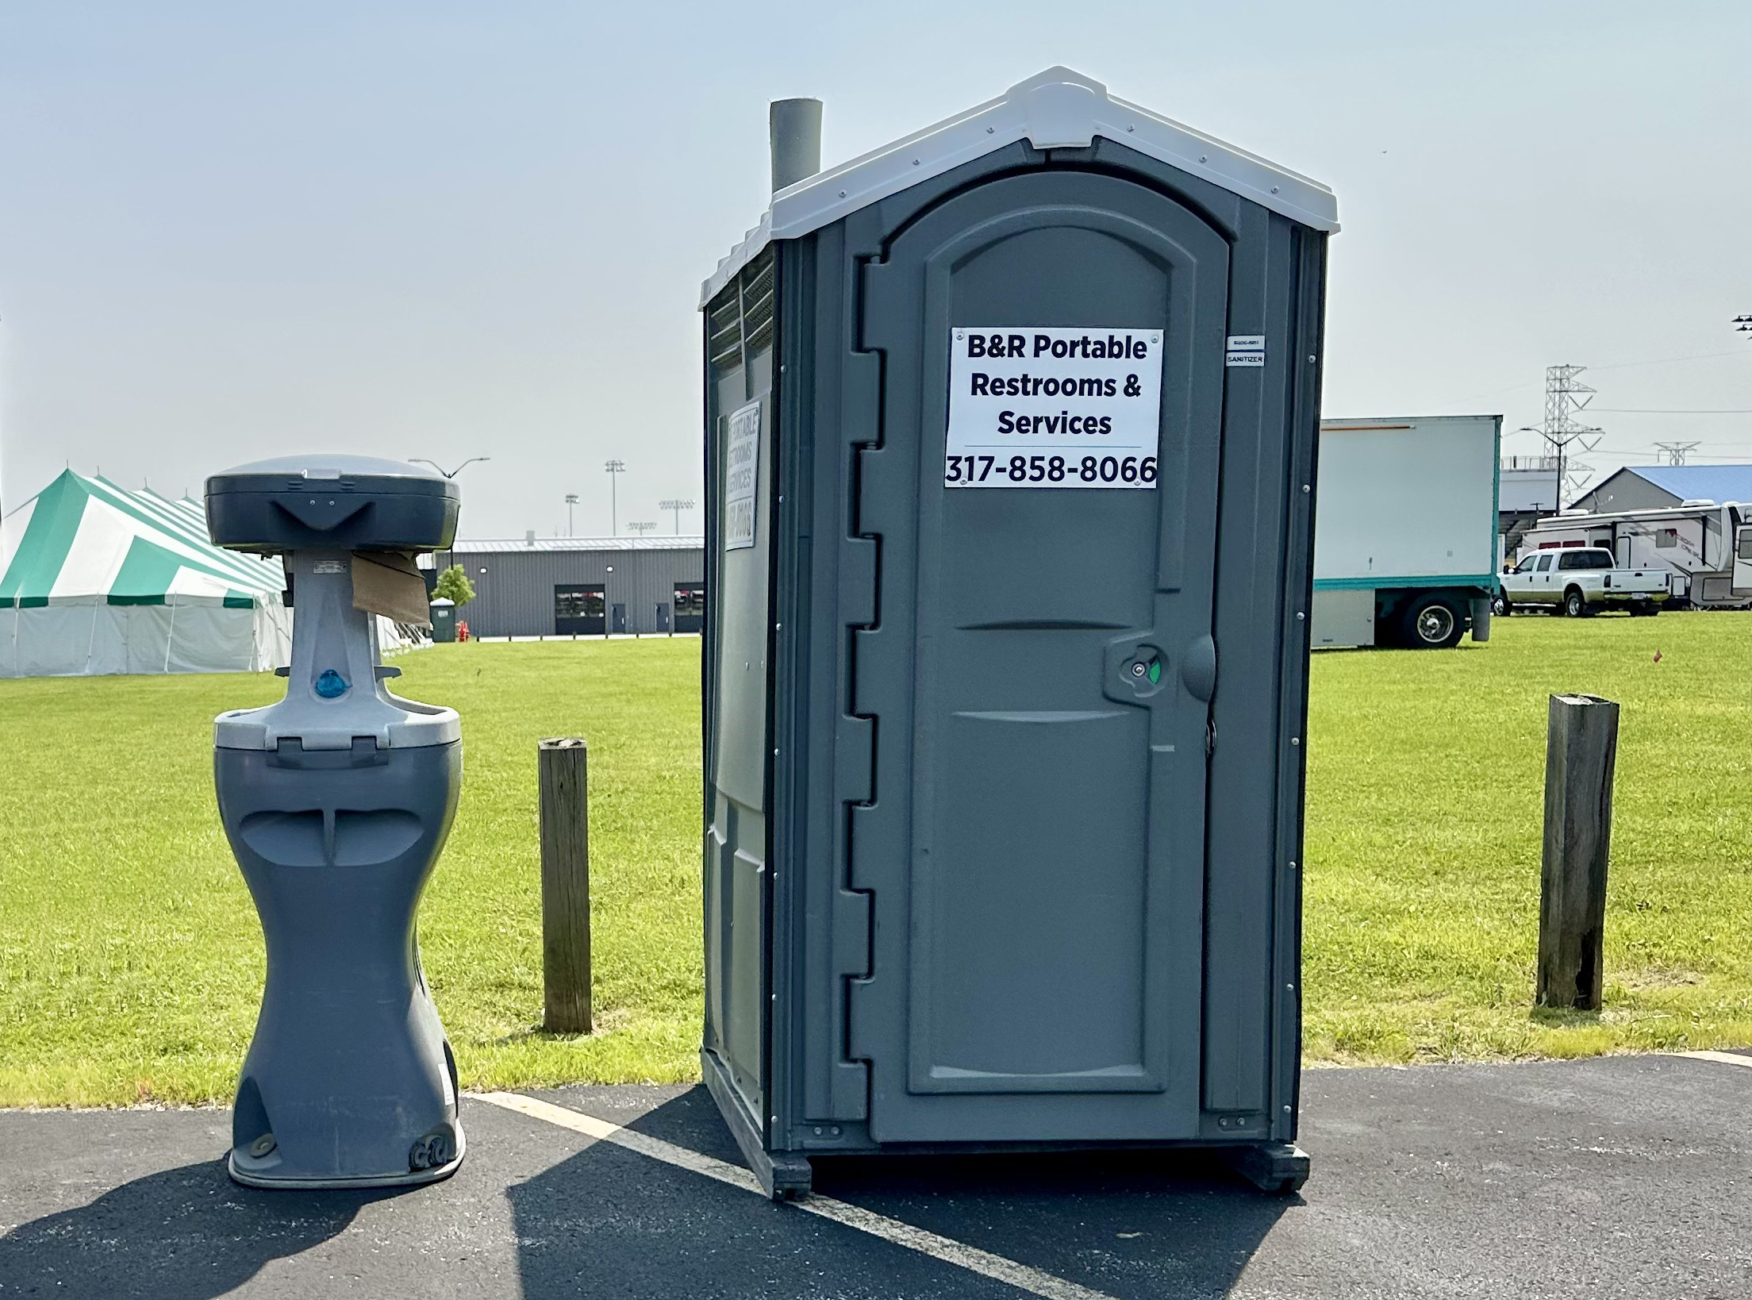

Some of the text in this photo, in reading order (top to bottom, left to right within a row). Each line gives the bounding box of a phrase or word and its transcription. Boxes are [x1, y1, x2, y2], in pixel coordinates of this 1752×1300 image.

[968, 334, 1147, 359] B&R Portable
[970, 372, 1141, 397] Restrooms &
[997, 410, 1112, 434] Services
[945, 455, 1157, 483] 317-858-8066
